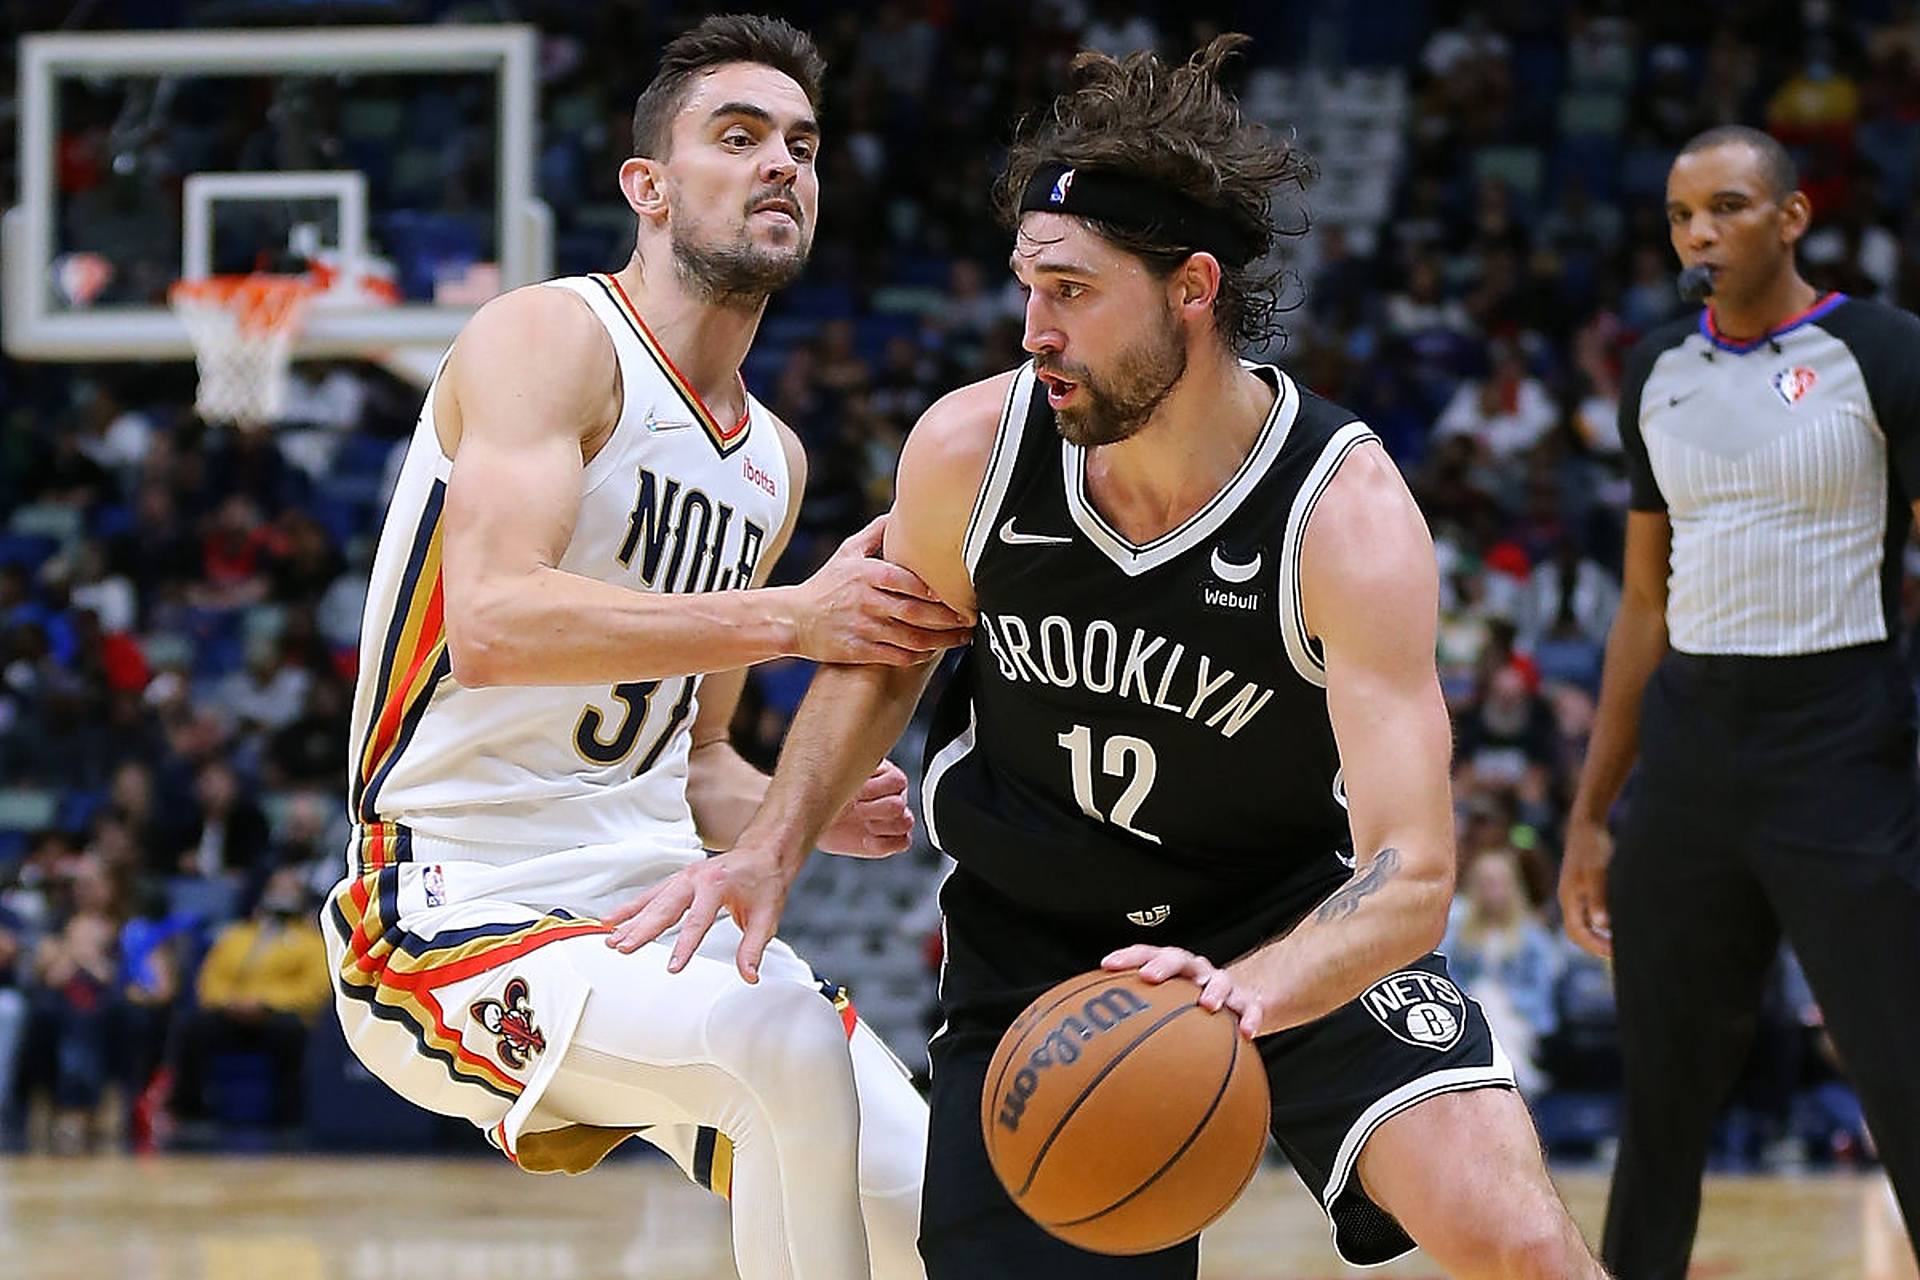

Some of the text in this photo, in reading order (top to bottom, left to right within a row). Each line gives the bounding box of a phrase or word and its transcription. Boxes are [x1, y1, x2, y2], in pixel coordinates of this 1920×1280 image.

[743, 456, 777, 497] ibotta
[1204, 588, 1259, 611] Webull
[980, 611, 1275, 739] BROOKLYN
[1056, 724, 1163, 845] 12
[1368, 974, 1462, 1021] NETS
[998, 987, 1151, 1133] Wilson
